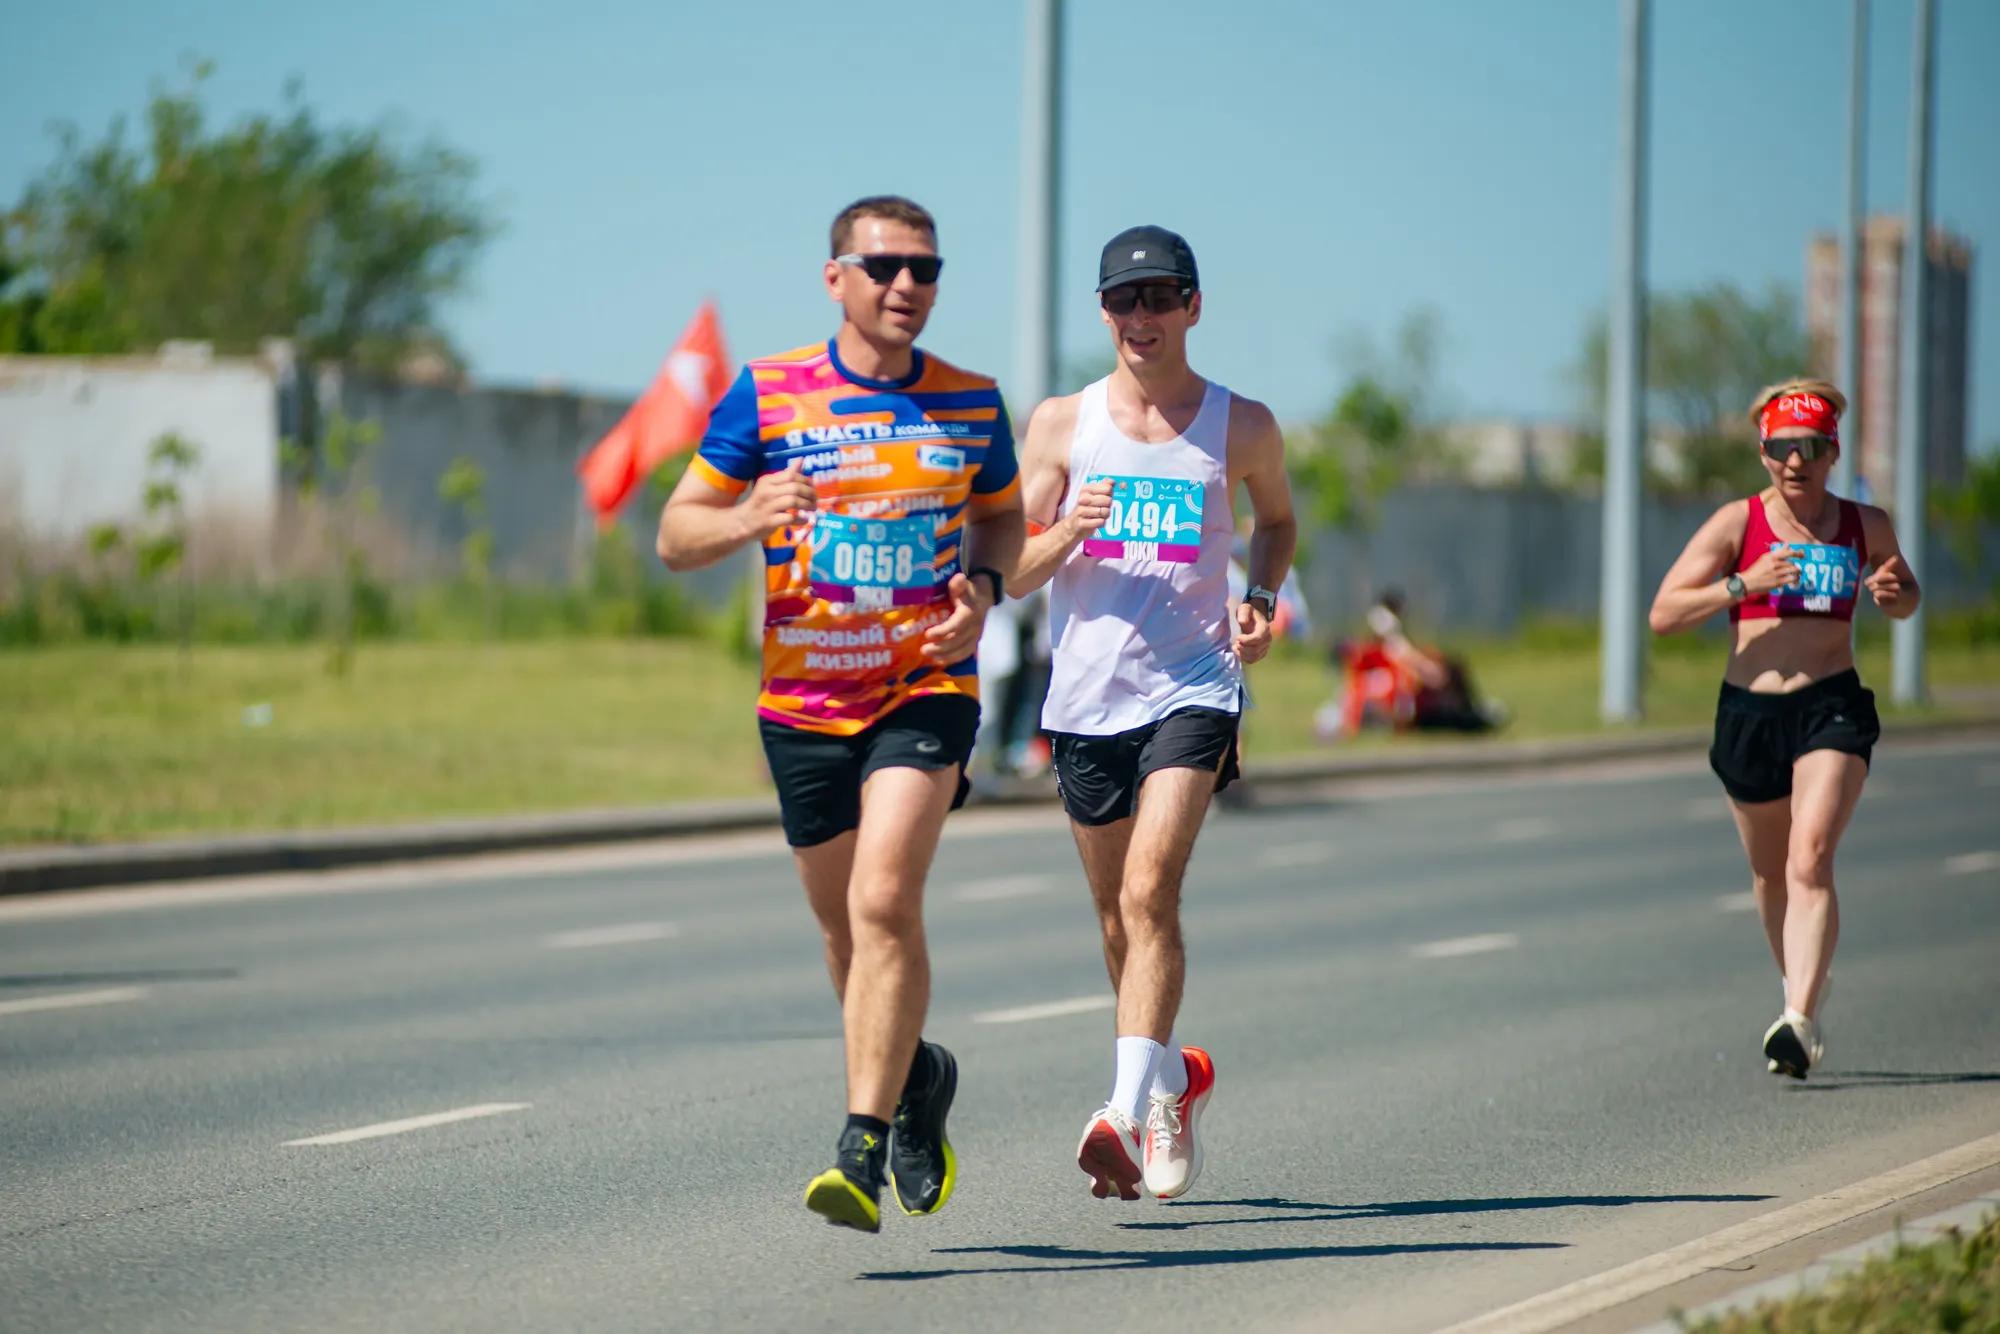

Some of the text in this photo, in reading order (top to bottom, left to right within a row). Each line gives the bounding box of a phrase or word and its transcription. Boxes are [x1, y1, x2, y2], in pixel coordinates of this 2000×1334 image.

[785, 429, 804, 447] Я
[807, 422, 892, 443] ЧАСТЬ
[1105, 499, 1178, 539] 0494
[834, 542, 913, 584] 0658
[805, 649, 892, 670] ЖИЗНИ
